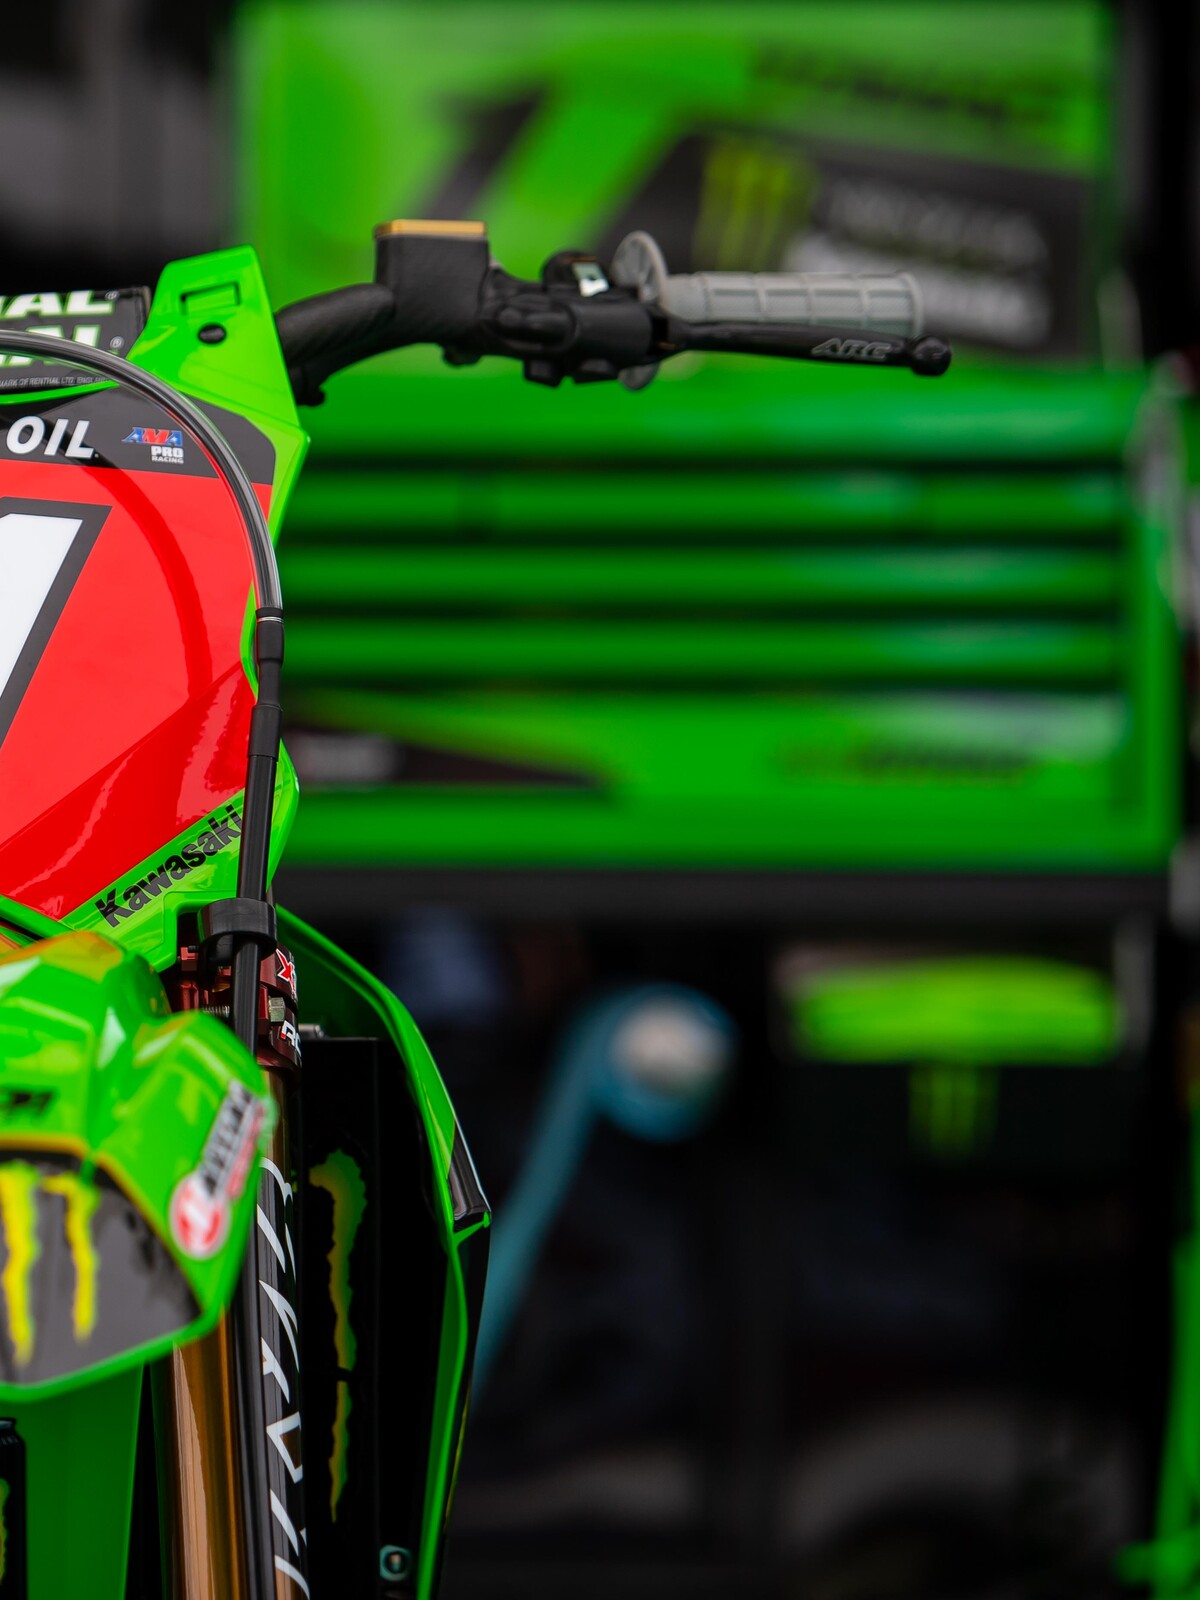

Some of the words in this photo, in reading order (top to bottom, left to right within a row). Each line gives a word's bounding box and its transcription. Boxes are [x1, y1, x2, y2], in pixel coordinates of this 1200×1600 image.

[811, 337, 891, 361] ARC
[19, 378, 28, 386] OF
[29, 377, 60, 385] RENTHAL
[6, 415, 95, 459] OIL
[121, 427, 183, 447] AMA
[151, 445, 184, 458] PRO
[151, 455, 184, 464] RACING
[95, 804, 243, 928] Kawasaki
